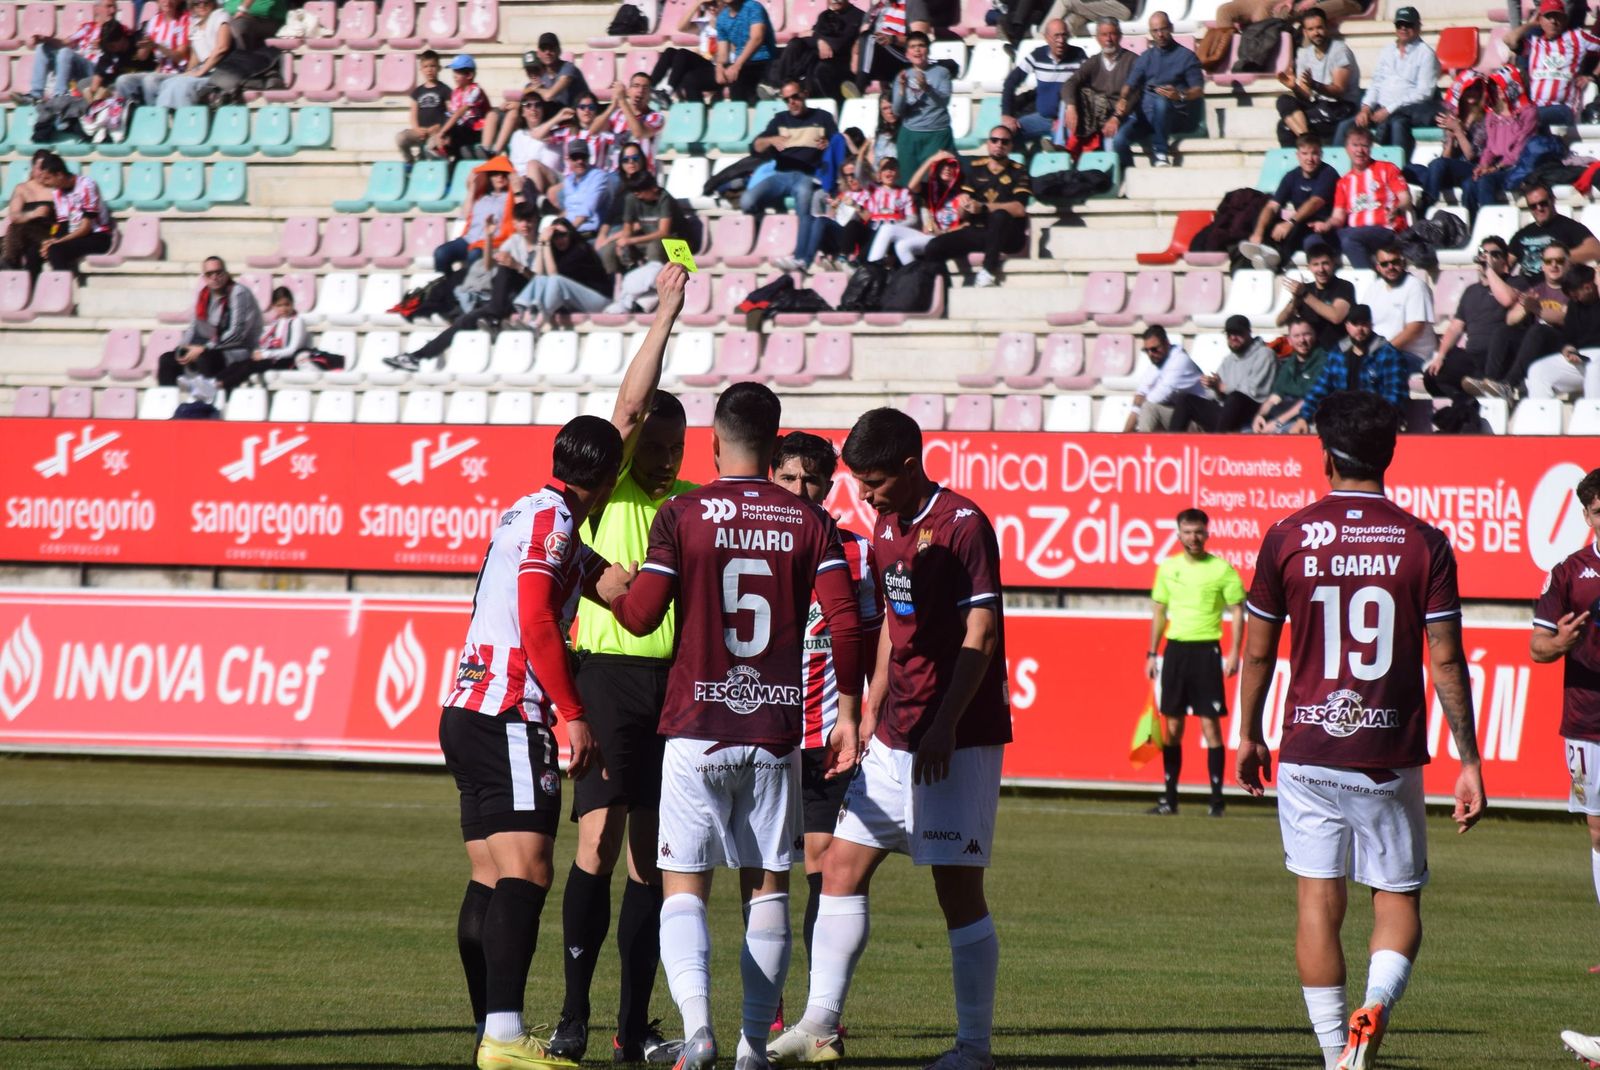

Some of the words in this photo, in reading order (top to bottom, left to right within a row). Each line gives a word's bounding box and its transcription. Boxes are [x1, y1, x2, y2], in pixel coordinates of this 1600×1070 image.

[103, 450, 129, 476] sgc
[290, 453, 317, 480] sgc
[460, 456, 488, 483] sgc
[922, 438, 1048, 492] Clínica
[1061, 442, 1191, 496] Dental
[1283, 457, 1302, 477] de
[741, 502, 803, 516] Deputación
[1199, 487, 1247, 512] Sangre
[1269, 488, 1305, 509] Local
[358, 494, 505, 549] sangregori
[742, 511, 803, 524] Pontevedra
[1207, 518, 1260, 538] AMORA
[1341, 524, 1406, 536] Deputación
[714, 527, 794, 552] ALVARO
[1341, 534, 1405, 544] Pontevedra
[1483, 521, 1521, 553] DE
[1304, 556, 1325, 577] B.
[1331, 554, 1401, 577] GARAY
[885, 572, 912, 589] Estrella
[887, 586, 913, 602] Galicia
[722, 557, 773, 658] 5
[1310, 585, 1396, 682] 19
[54, 642, 205, 702] INNOVA
[216, 646, 330, 722] Chef
[694, 681, 800, 706] PESCAMAR
[1293, 704, 1400, 729] PESCAMAR
[1567, 745, 1586, 775] 21
[922, 831, 962, 842] ABANCA
